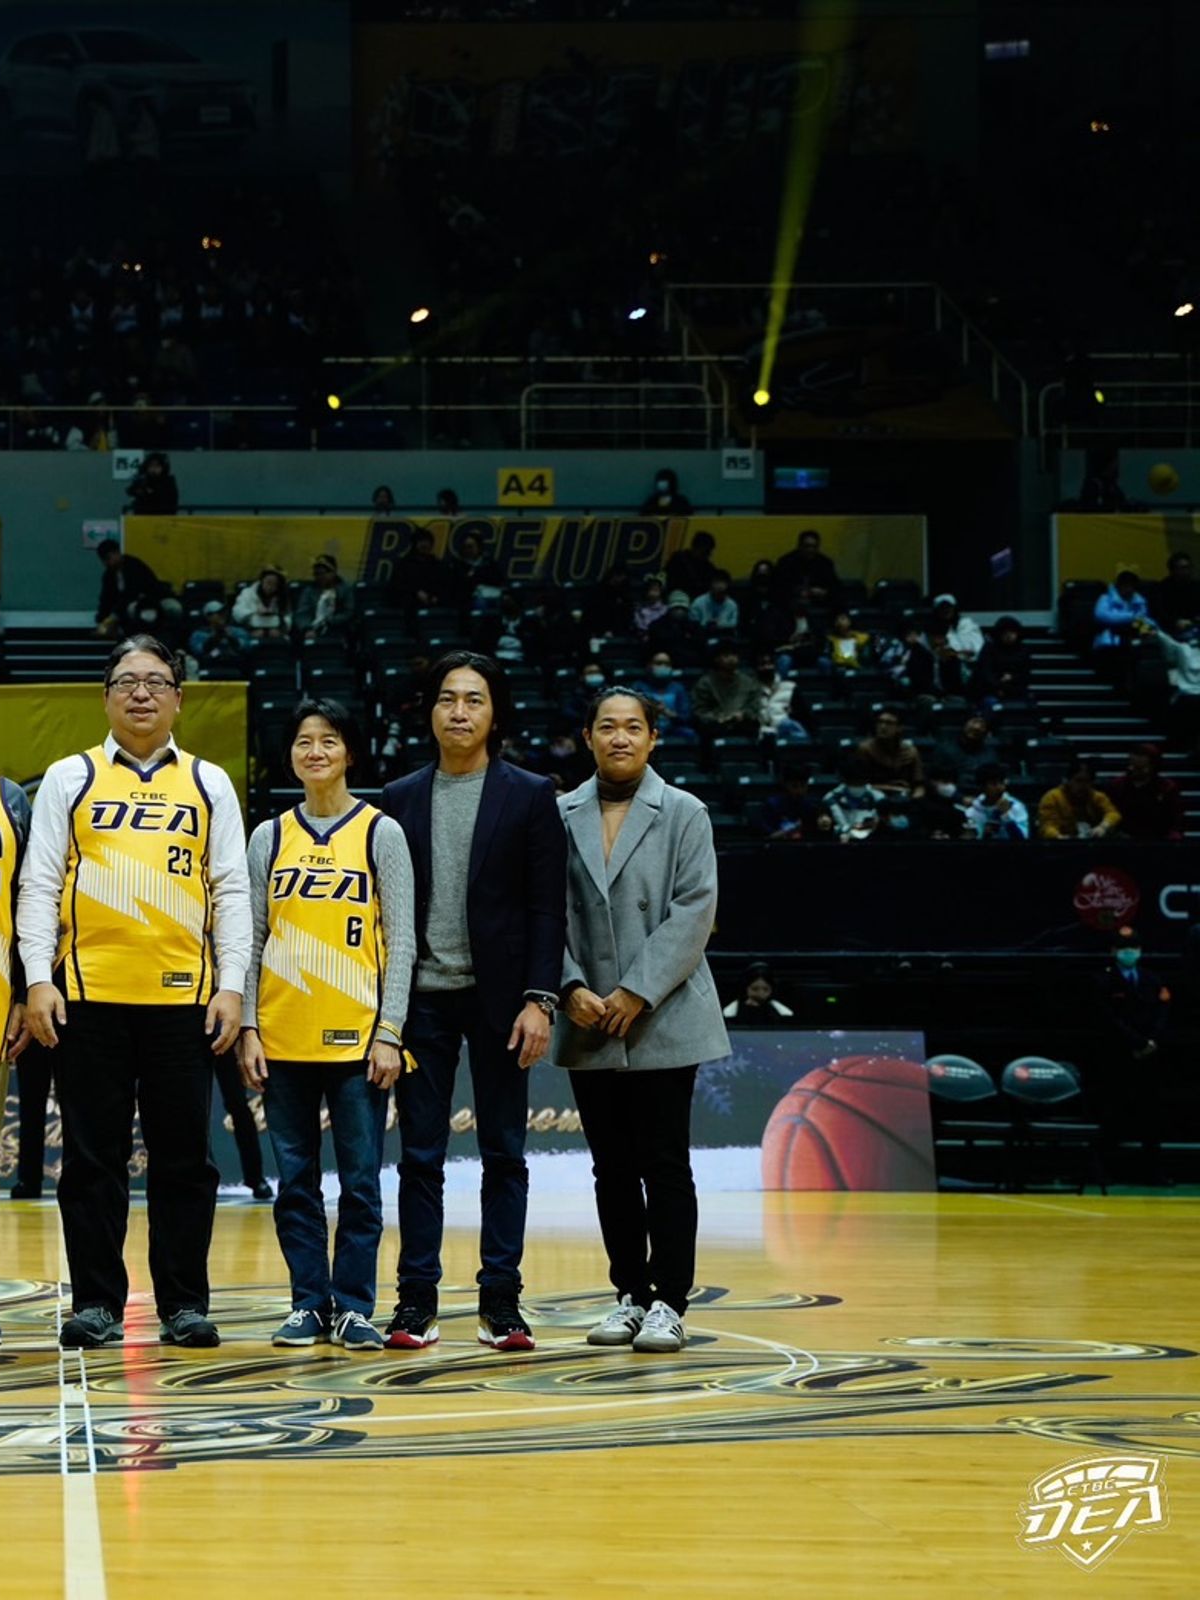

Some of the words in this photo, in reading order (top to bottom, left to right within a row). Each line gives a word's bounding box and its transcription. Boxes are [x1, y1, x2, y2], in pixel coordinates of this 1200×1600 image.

[502, 473, 549, 496] A4
[129, 791, 169, 801] CTBC
[90, 800, 199, 838] DEA
[167, 844, 193, 878] 23
[298, 854, 336, 865] CTBC
[272, 867, 368, 904] DEA
[345, 915, 363, 948] 6
